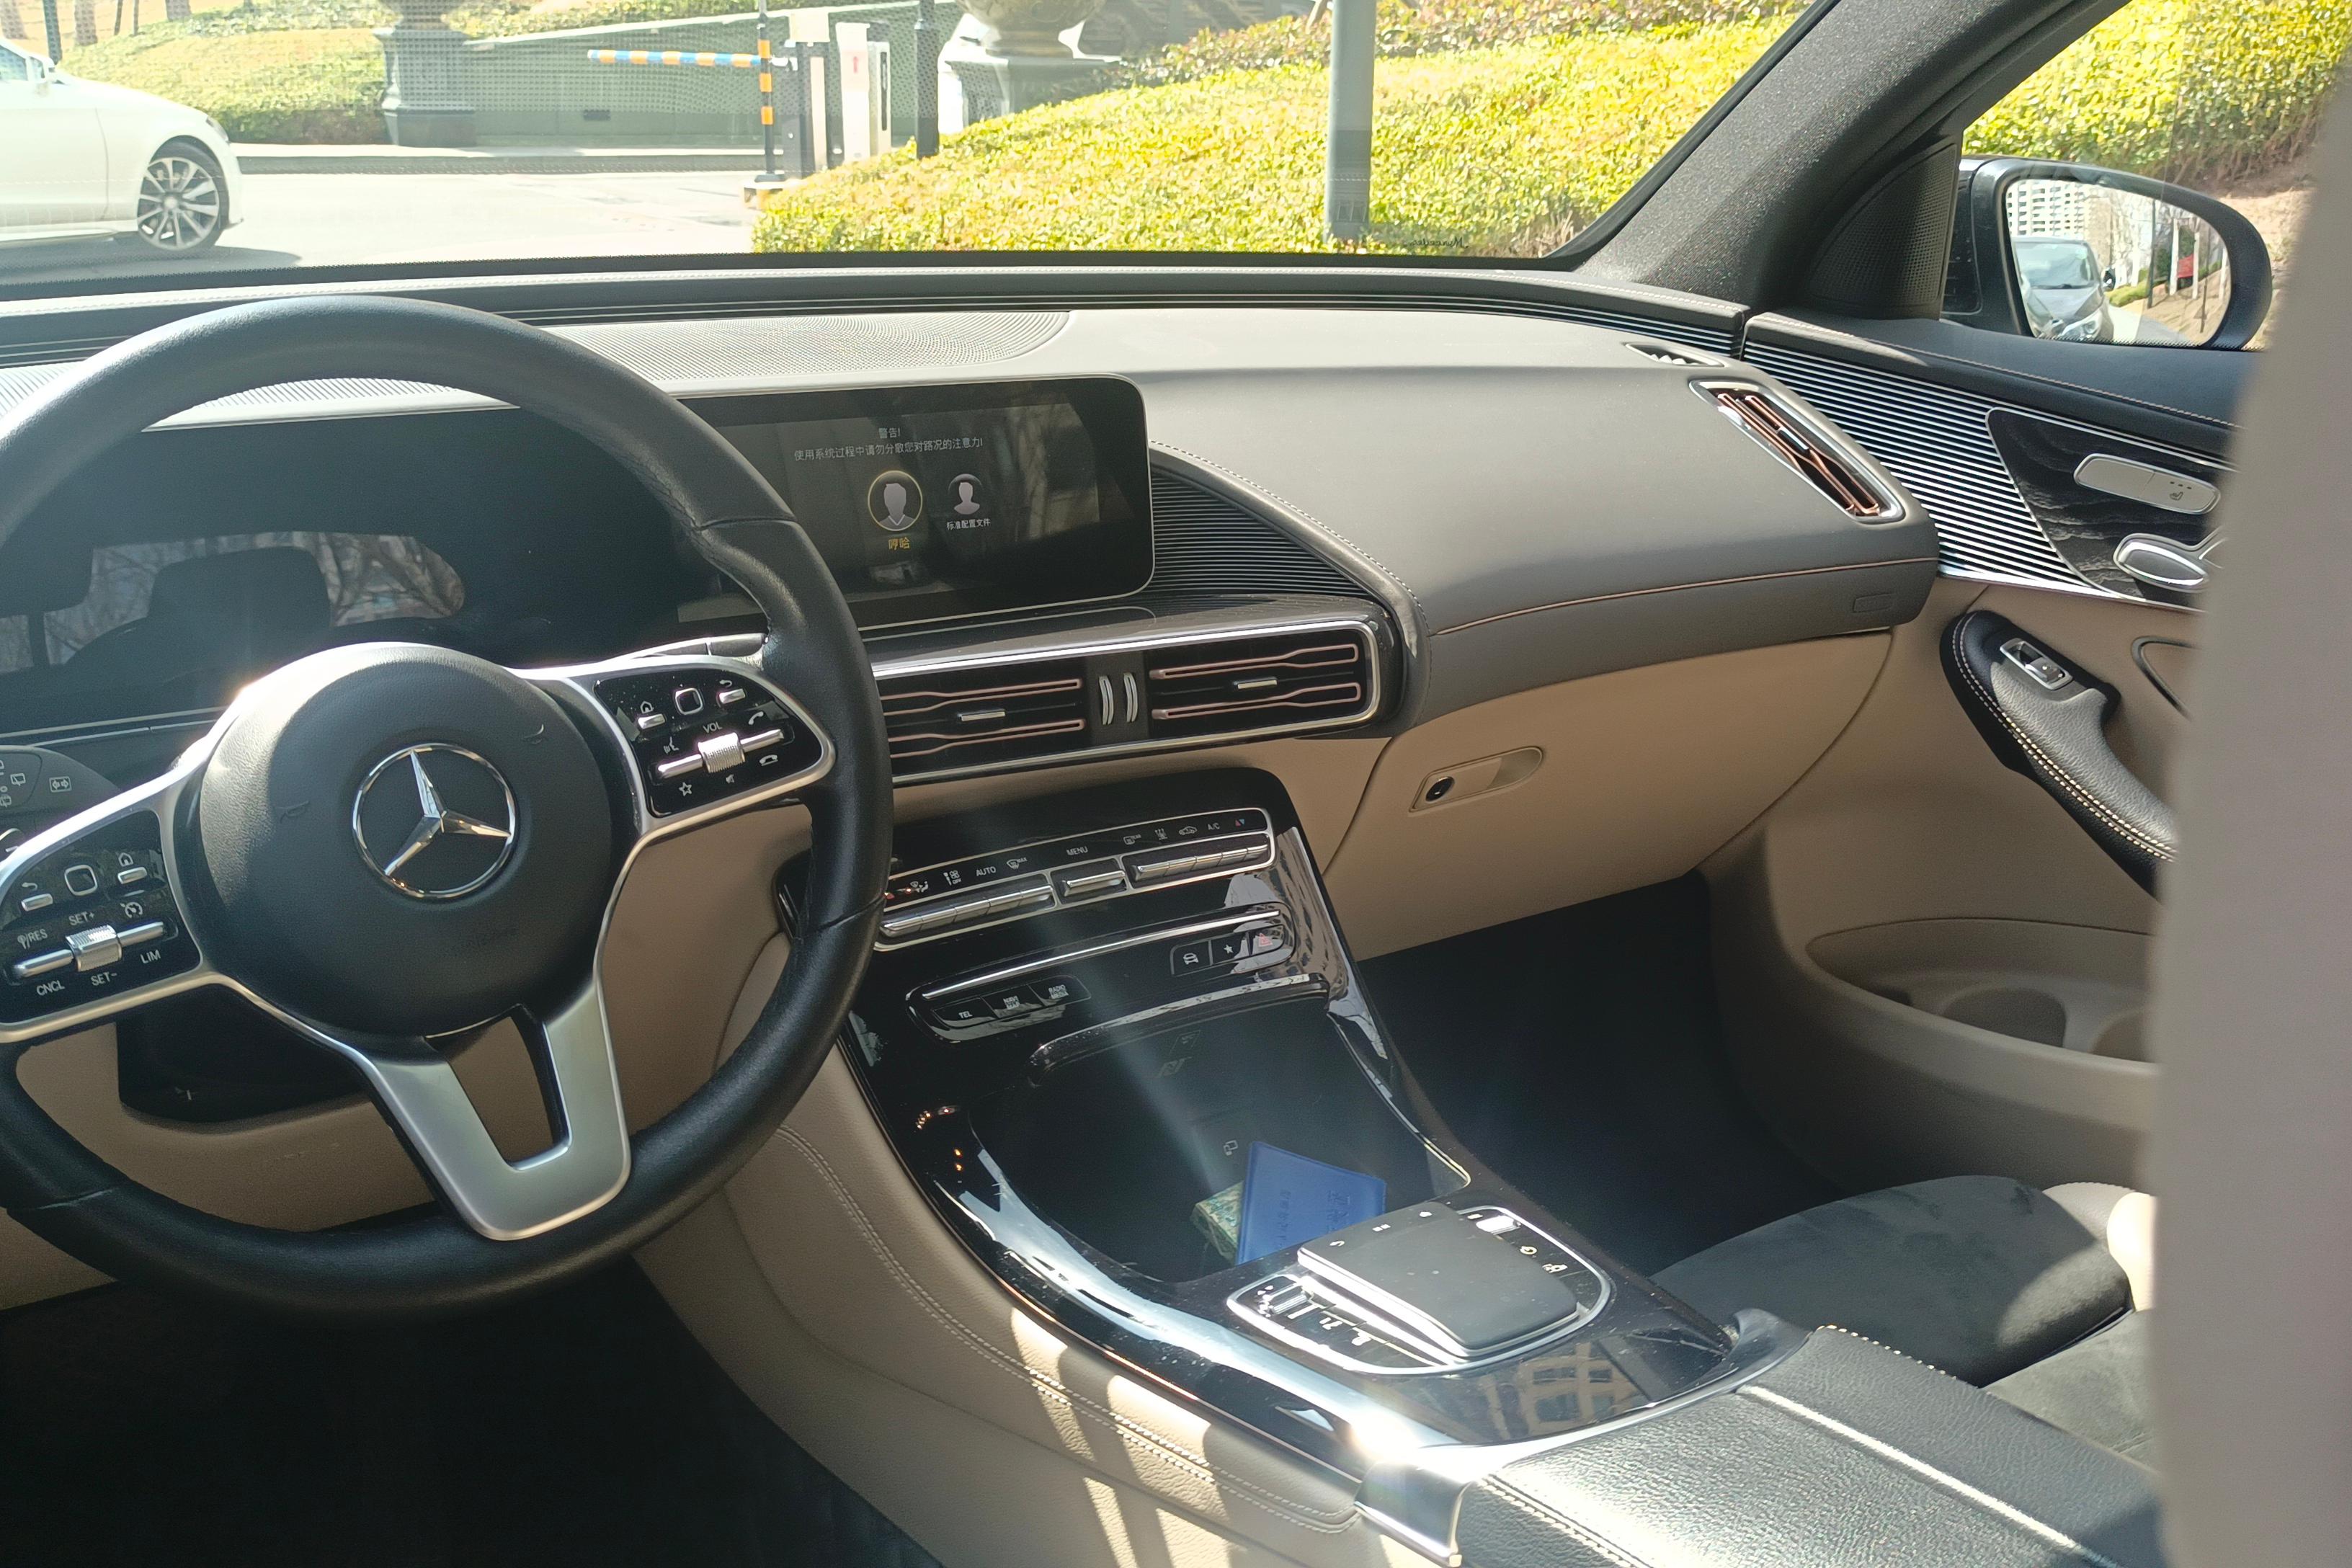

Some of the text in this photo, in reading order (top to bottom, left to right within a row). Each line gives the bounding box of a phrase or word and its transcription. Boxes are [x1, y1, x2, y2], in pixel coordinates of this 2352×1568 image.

[878, 427, 901, 439] 警告!
[794, 437, 983, 461] 使用系统过程中请勿分散您对路况的注意力!
[946, 517, 992, 530] 标准配置文件
[703, 721, 723, 734] VOL
[1207, 822, 1220, 831] A/C
[1066, 846, 1089, 856] MENU
[976, 865, 997, 877] AUTO
[68, 911, 95, 926] SET+
[140, 949, 161, 964] LIM
[90, 971, 117, 986] SET-
[36, 979, 66, 996] CNCL
[958, 1010, 973, 1019] TEL
